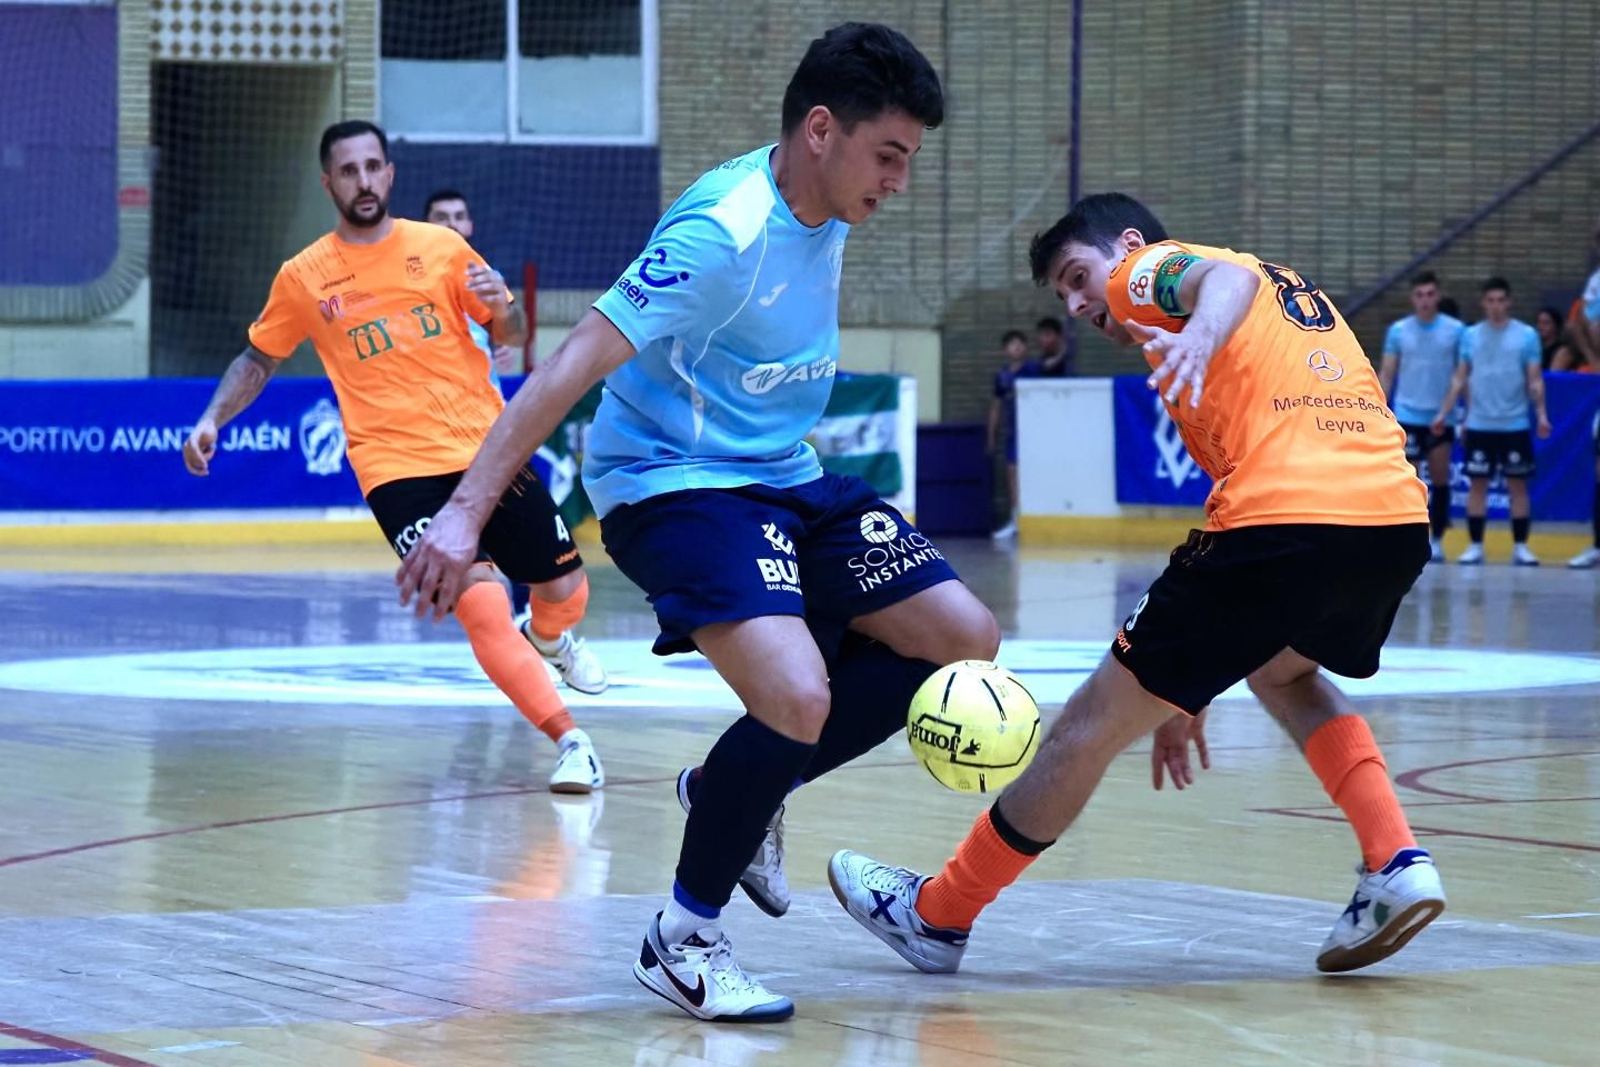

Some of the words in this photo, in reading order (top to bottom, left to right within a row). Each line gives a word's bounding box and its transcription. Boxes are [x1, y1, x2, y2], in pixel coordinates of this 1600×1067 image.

[1259, 262, 1336, 332] 8
[110, 426, 198, 452] AVANT
[221, 420, 291, 451] JAÉN
[1316, 417, 1366, 433] Leyva
[555, 514, 570, 542] 4
[848, 532, 933, 577] SOMO
[756, 558, 800, 586] BU
[911, 720, 962, 753] Joma
